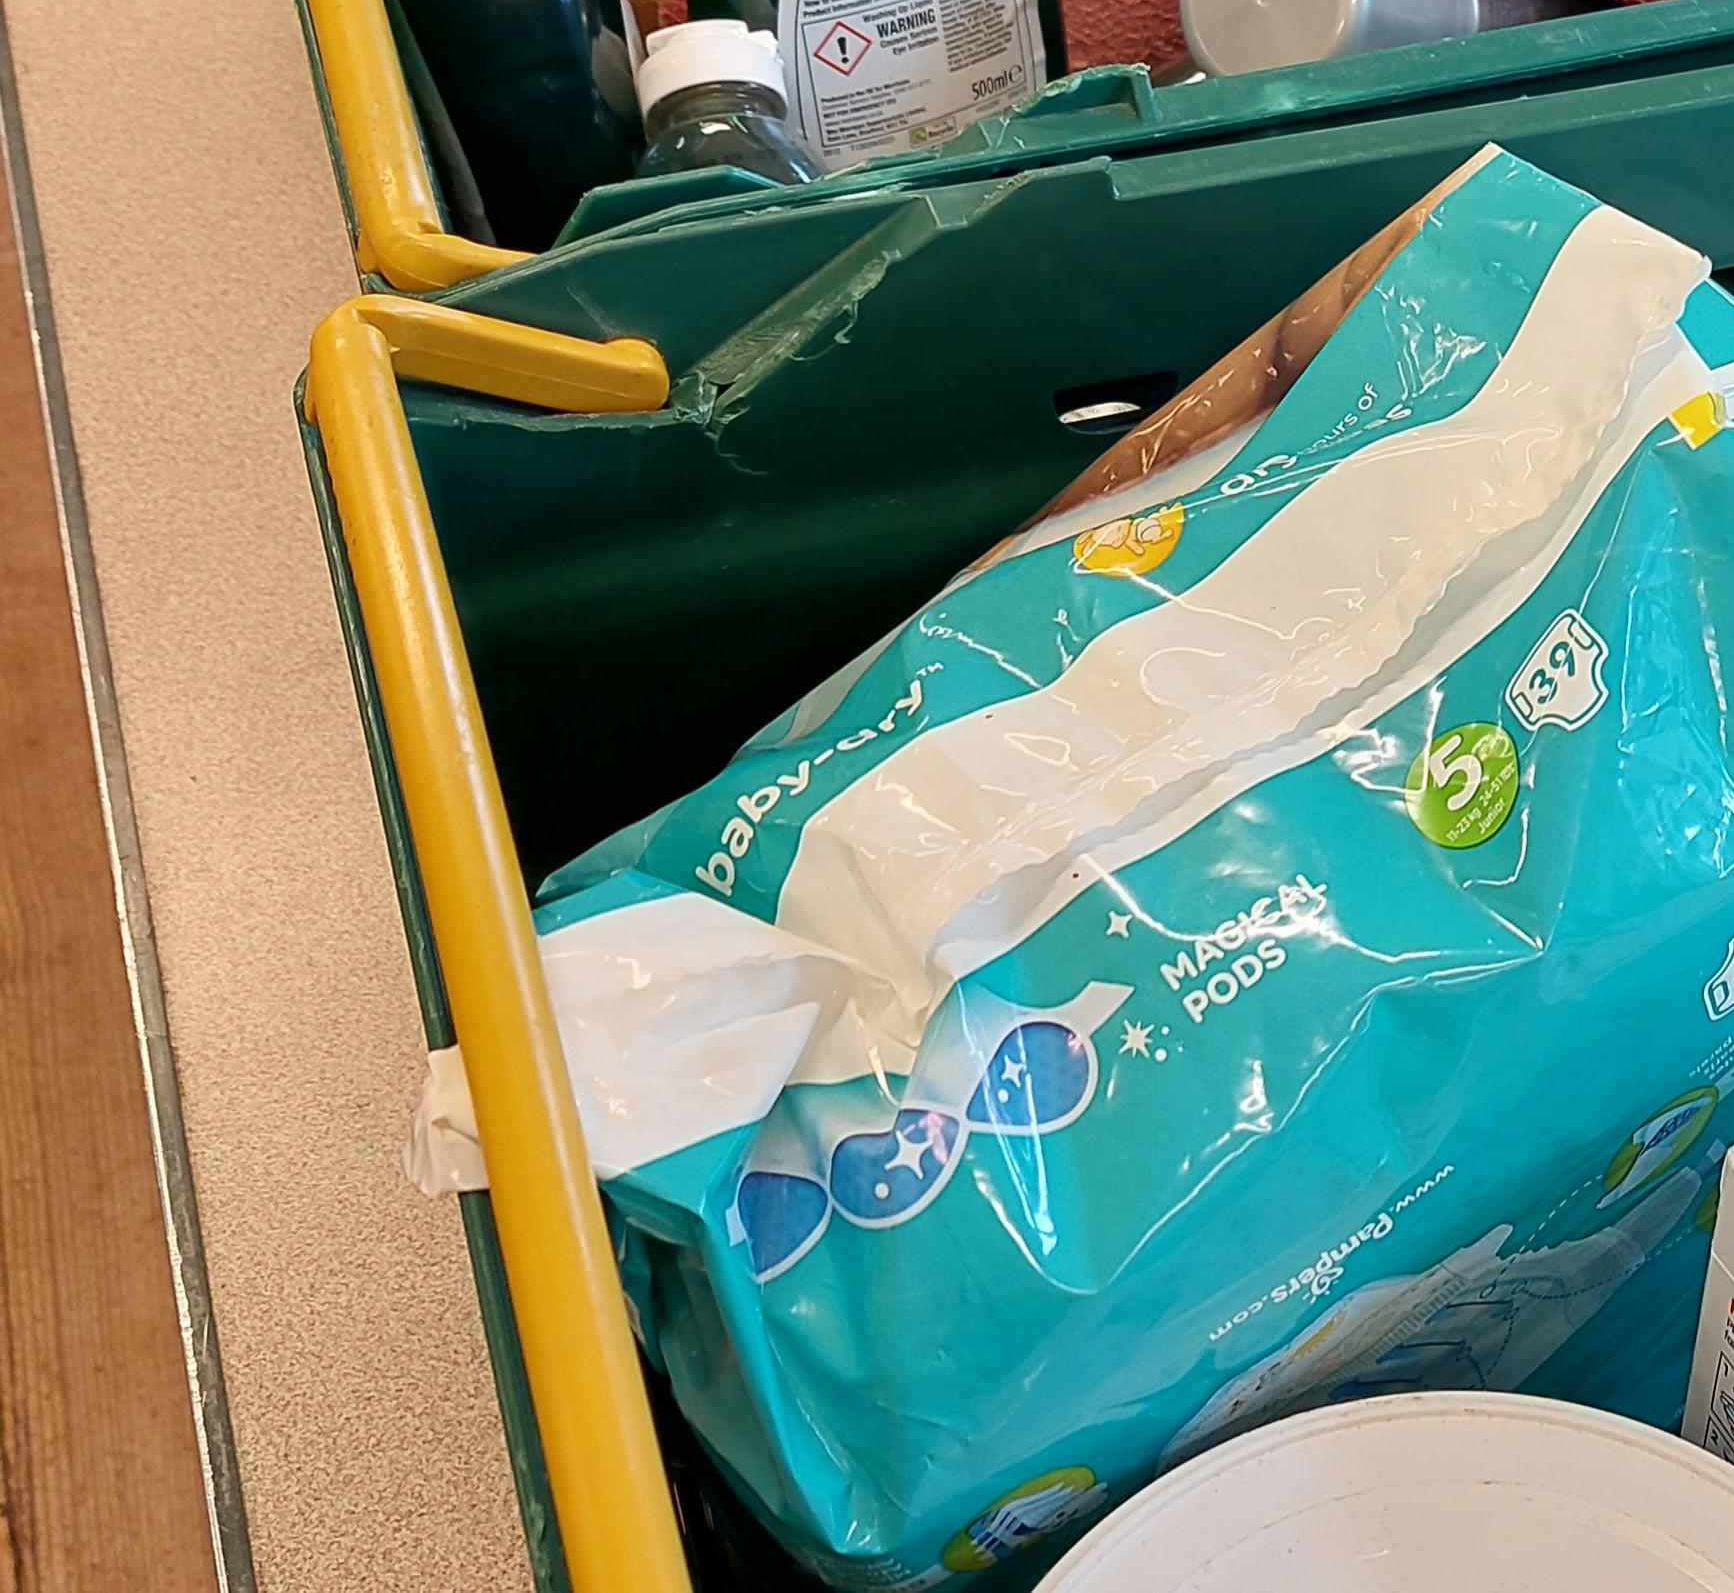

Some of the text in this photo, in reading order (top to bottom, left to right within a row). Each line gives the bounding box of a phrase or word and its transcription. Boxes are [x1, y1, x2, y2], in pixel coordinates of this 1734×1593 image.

[876, 9, 936, 39] WARNING
[971, 75, 1009, 100] 500ml
[1529, 641, 1575, 703] 39
[1430, 734, 1483, 811] 5
[1479, 796, 1507, 834] Junior
[1160, 873, 1328, 991] MAGICAL
[1182, 939, 1287, 1023] PODS
[1209, 1164, 1454, 1341] www.Pampers.com
[1709, 1431, 1720, 1447] 2
